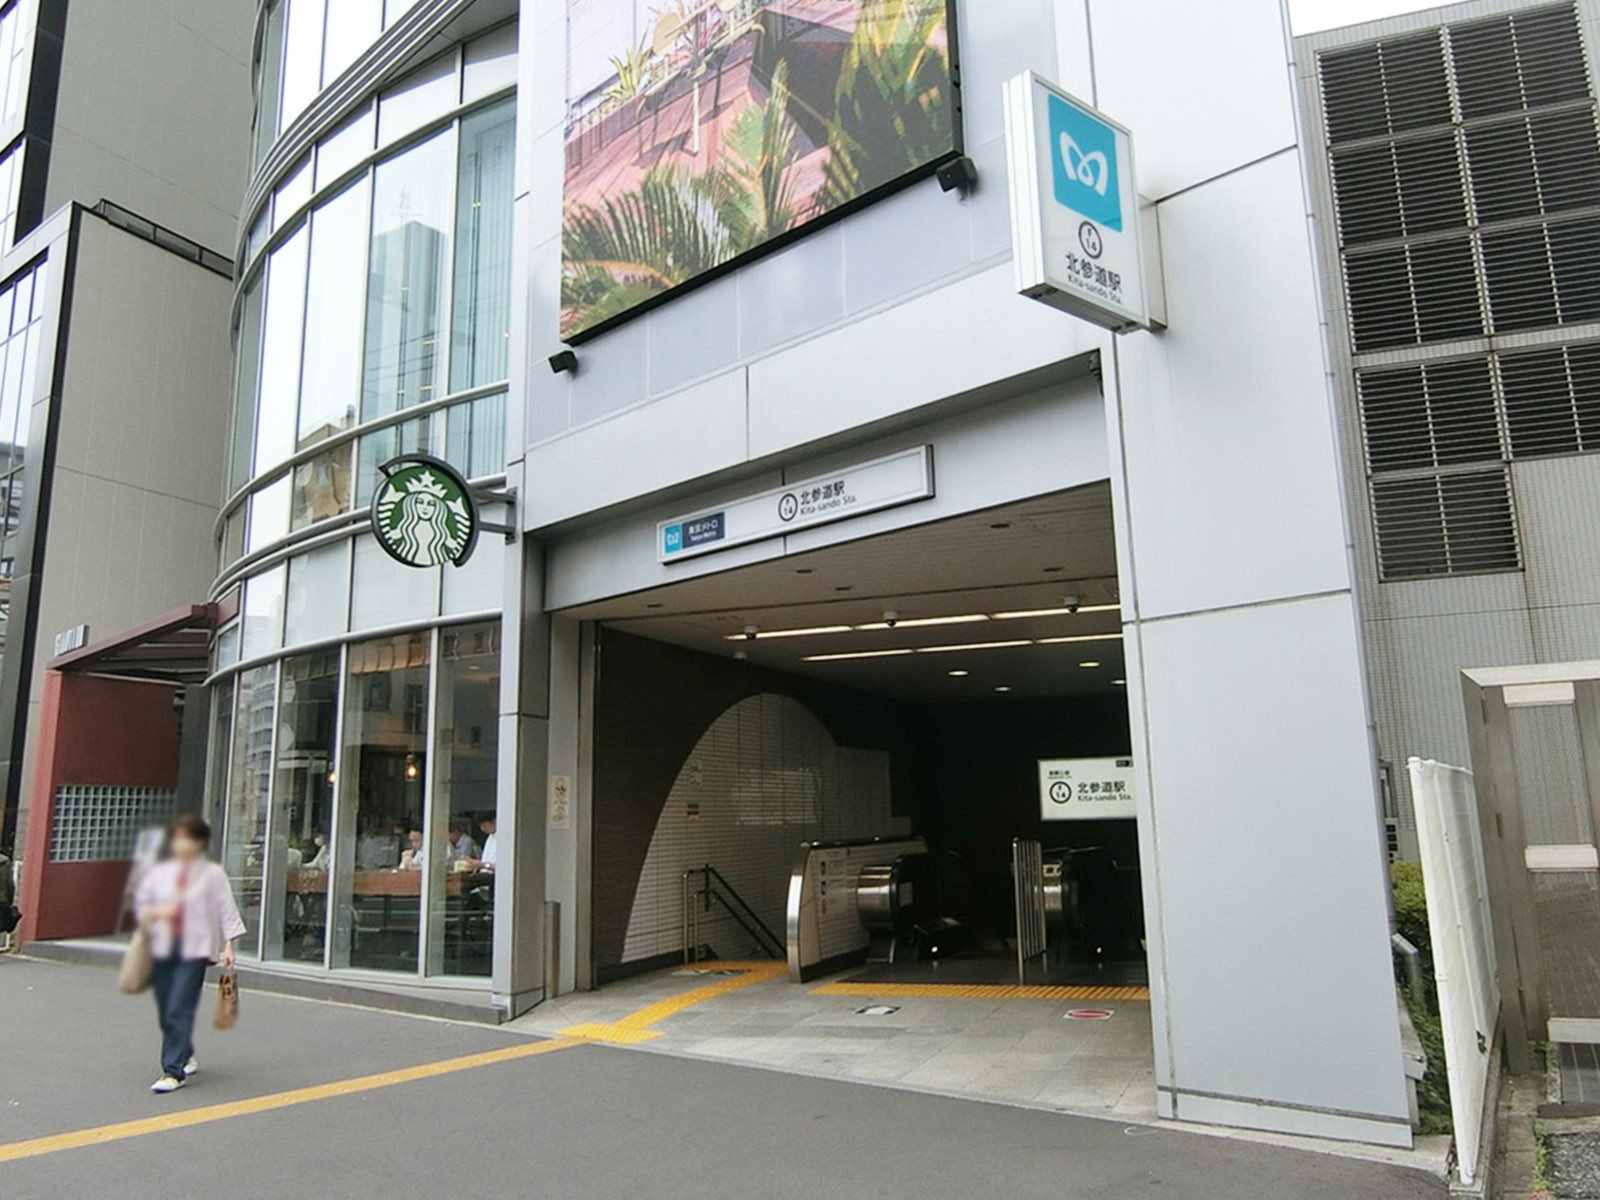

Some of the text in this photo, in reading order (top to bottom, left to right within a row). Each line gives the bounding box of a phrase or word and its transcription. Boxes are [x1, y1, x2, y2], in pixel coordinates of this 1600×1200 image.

[1066, 252, 1122, 294] 北参道駅
[801, 480, 845, 505] 北参道駅
[801, 498, 841, 514] Kita-sando
[1078, 781, 1125, 793] 北参道駅
